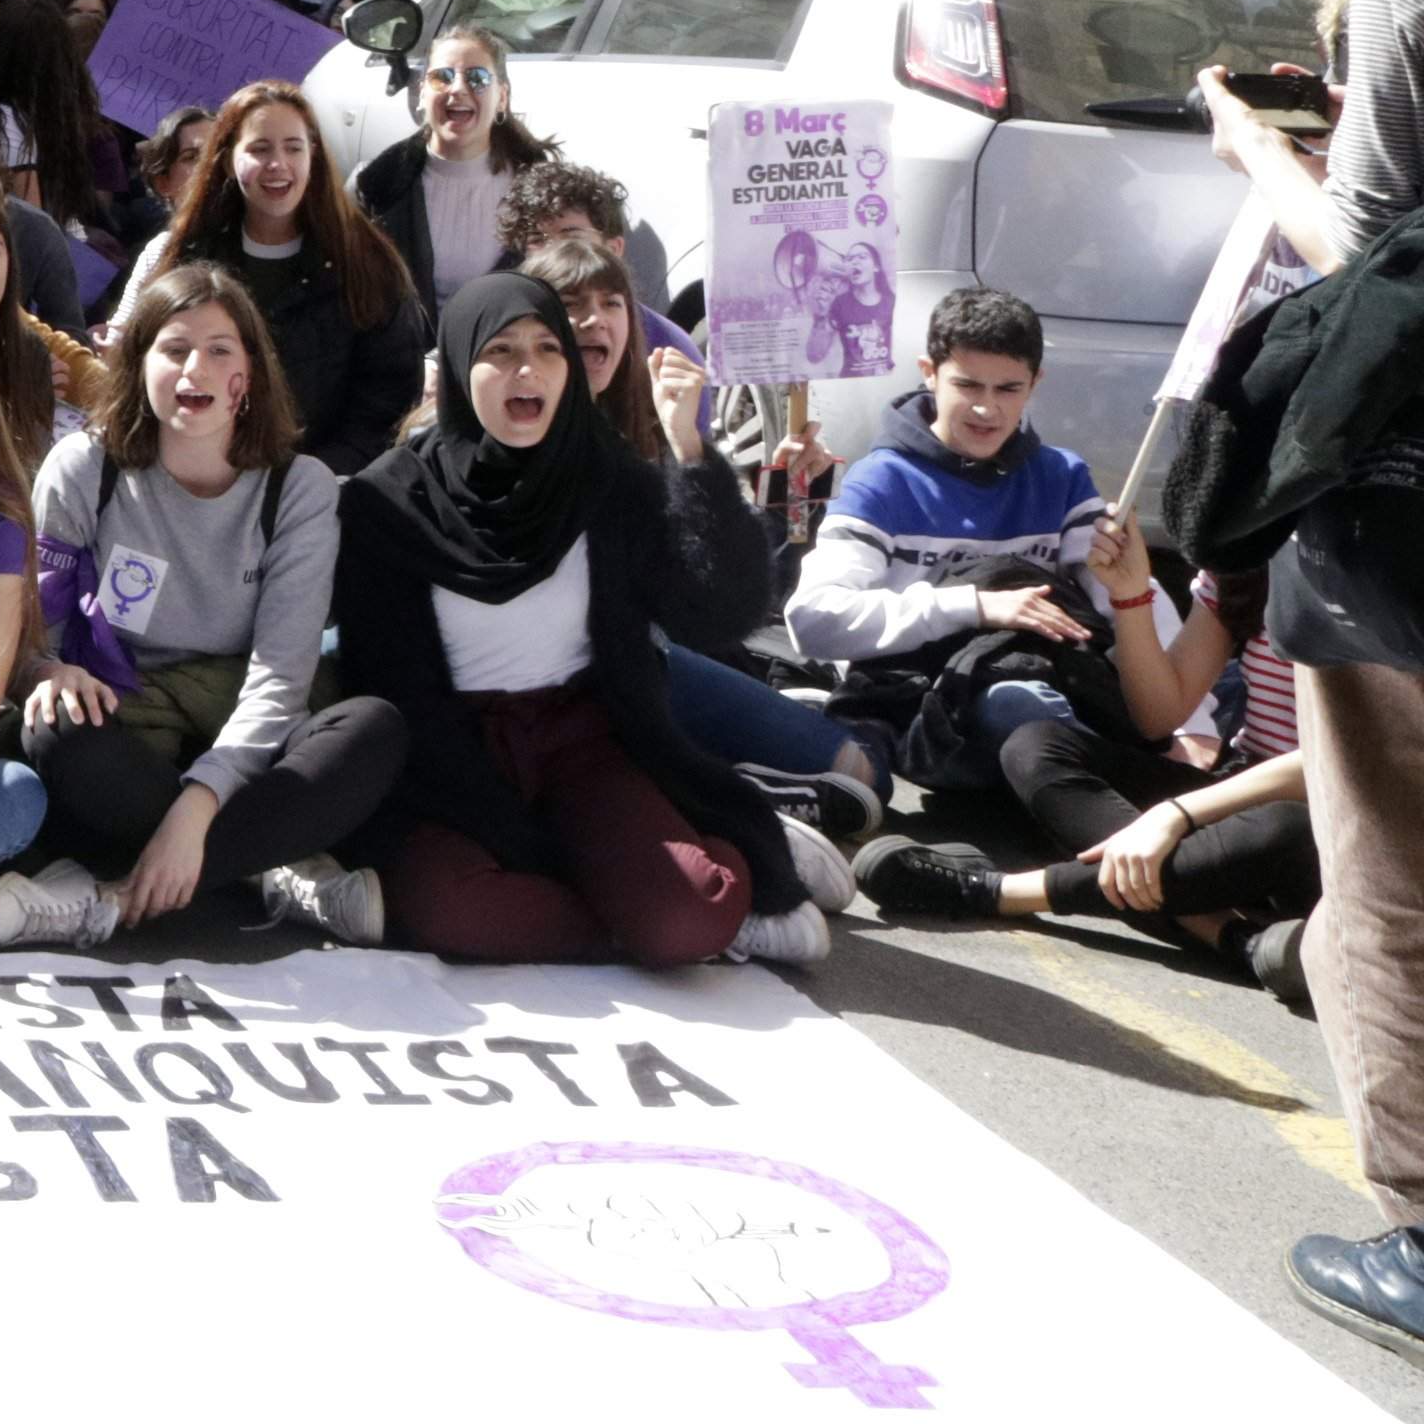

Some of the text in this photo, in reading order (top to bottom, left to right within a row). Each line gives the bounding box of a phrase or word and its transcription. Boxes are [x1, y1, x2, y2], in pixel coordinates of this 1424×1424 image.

[138, 22, 225, 83] CONTRA
[744, 108, 847, 137] 8 Març
[785, 138, 847, 159] VAGA
[747, 161, 847, 184] GENERAL
[732, 181, 848, 205] ESTUDIANTIL
